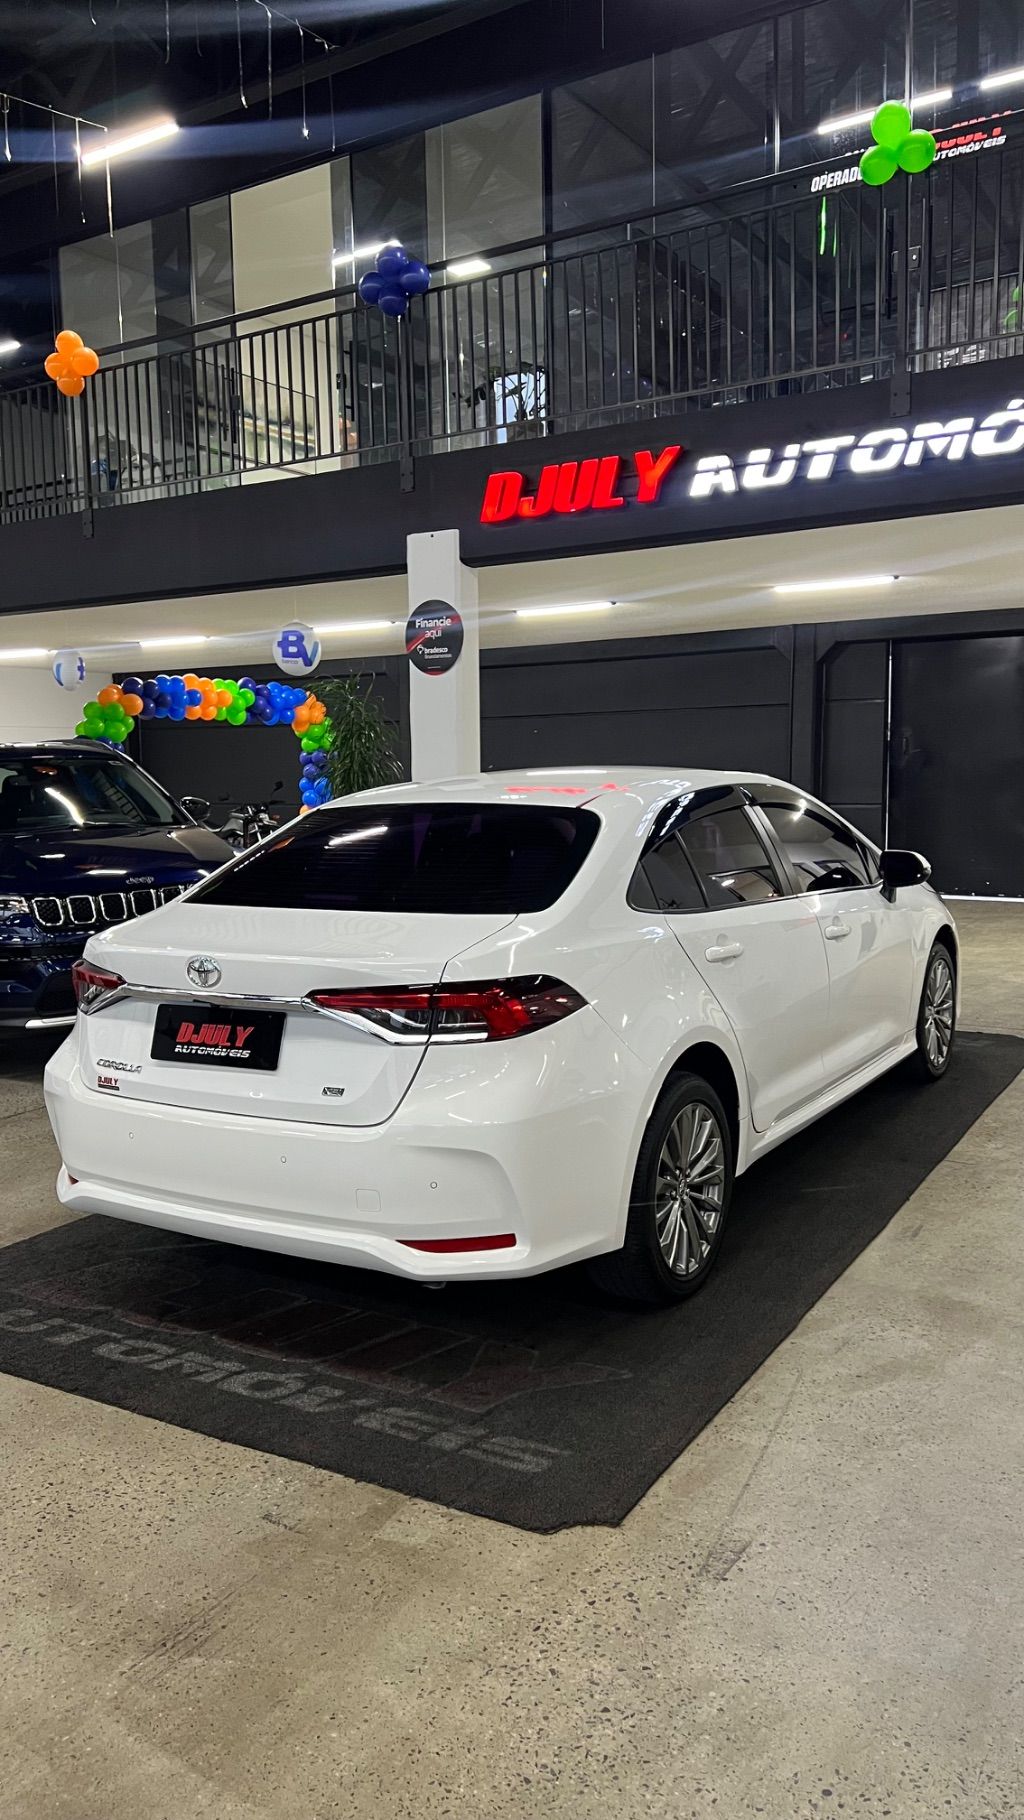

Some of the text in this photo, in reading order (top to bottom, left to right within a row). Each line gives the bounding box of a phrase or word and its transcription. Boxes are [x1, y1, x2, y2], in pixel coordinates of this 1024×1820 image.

[933, 135, 1006, 161] UTOMÓVEIS
[479, 398, 1024, 524] DJULY AUTOMÓ
[415, 616, 452, 628] Financie
[425, 629, 442, 639] aqui
[175, 1022, 255, 1047] DJULY
[174, 1045, 251, 1058] AUTOMÓVEIS
